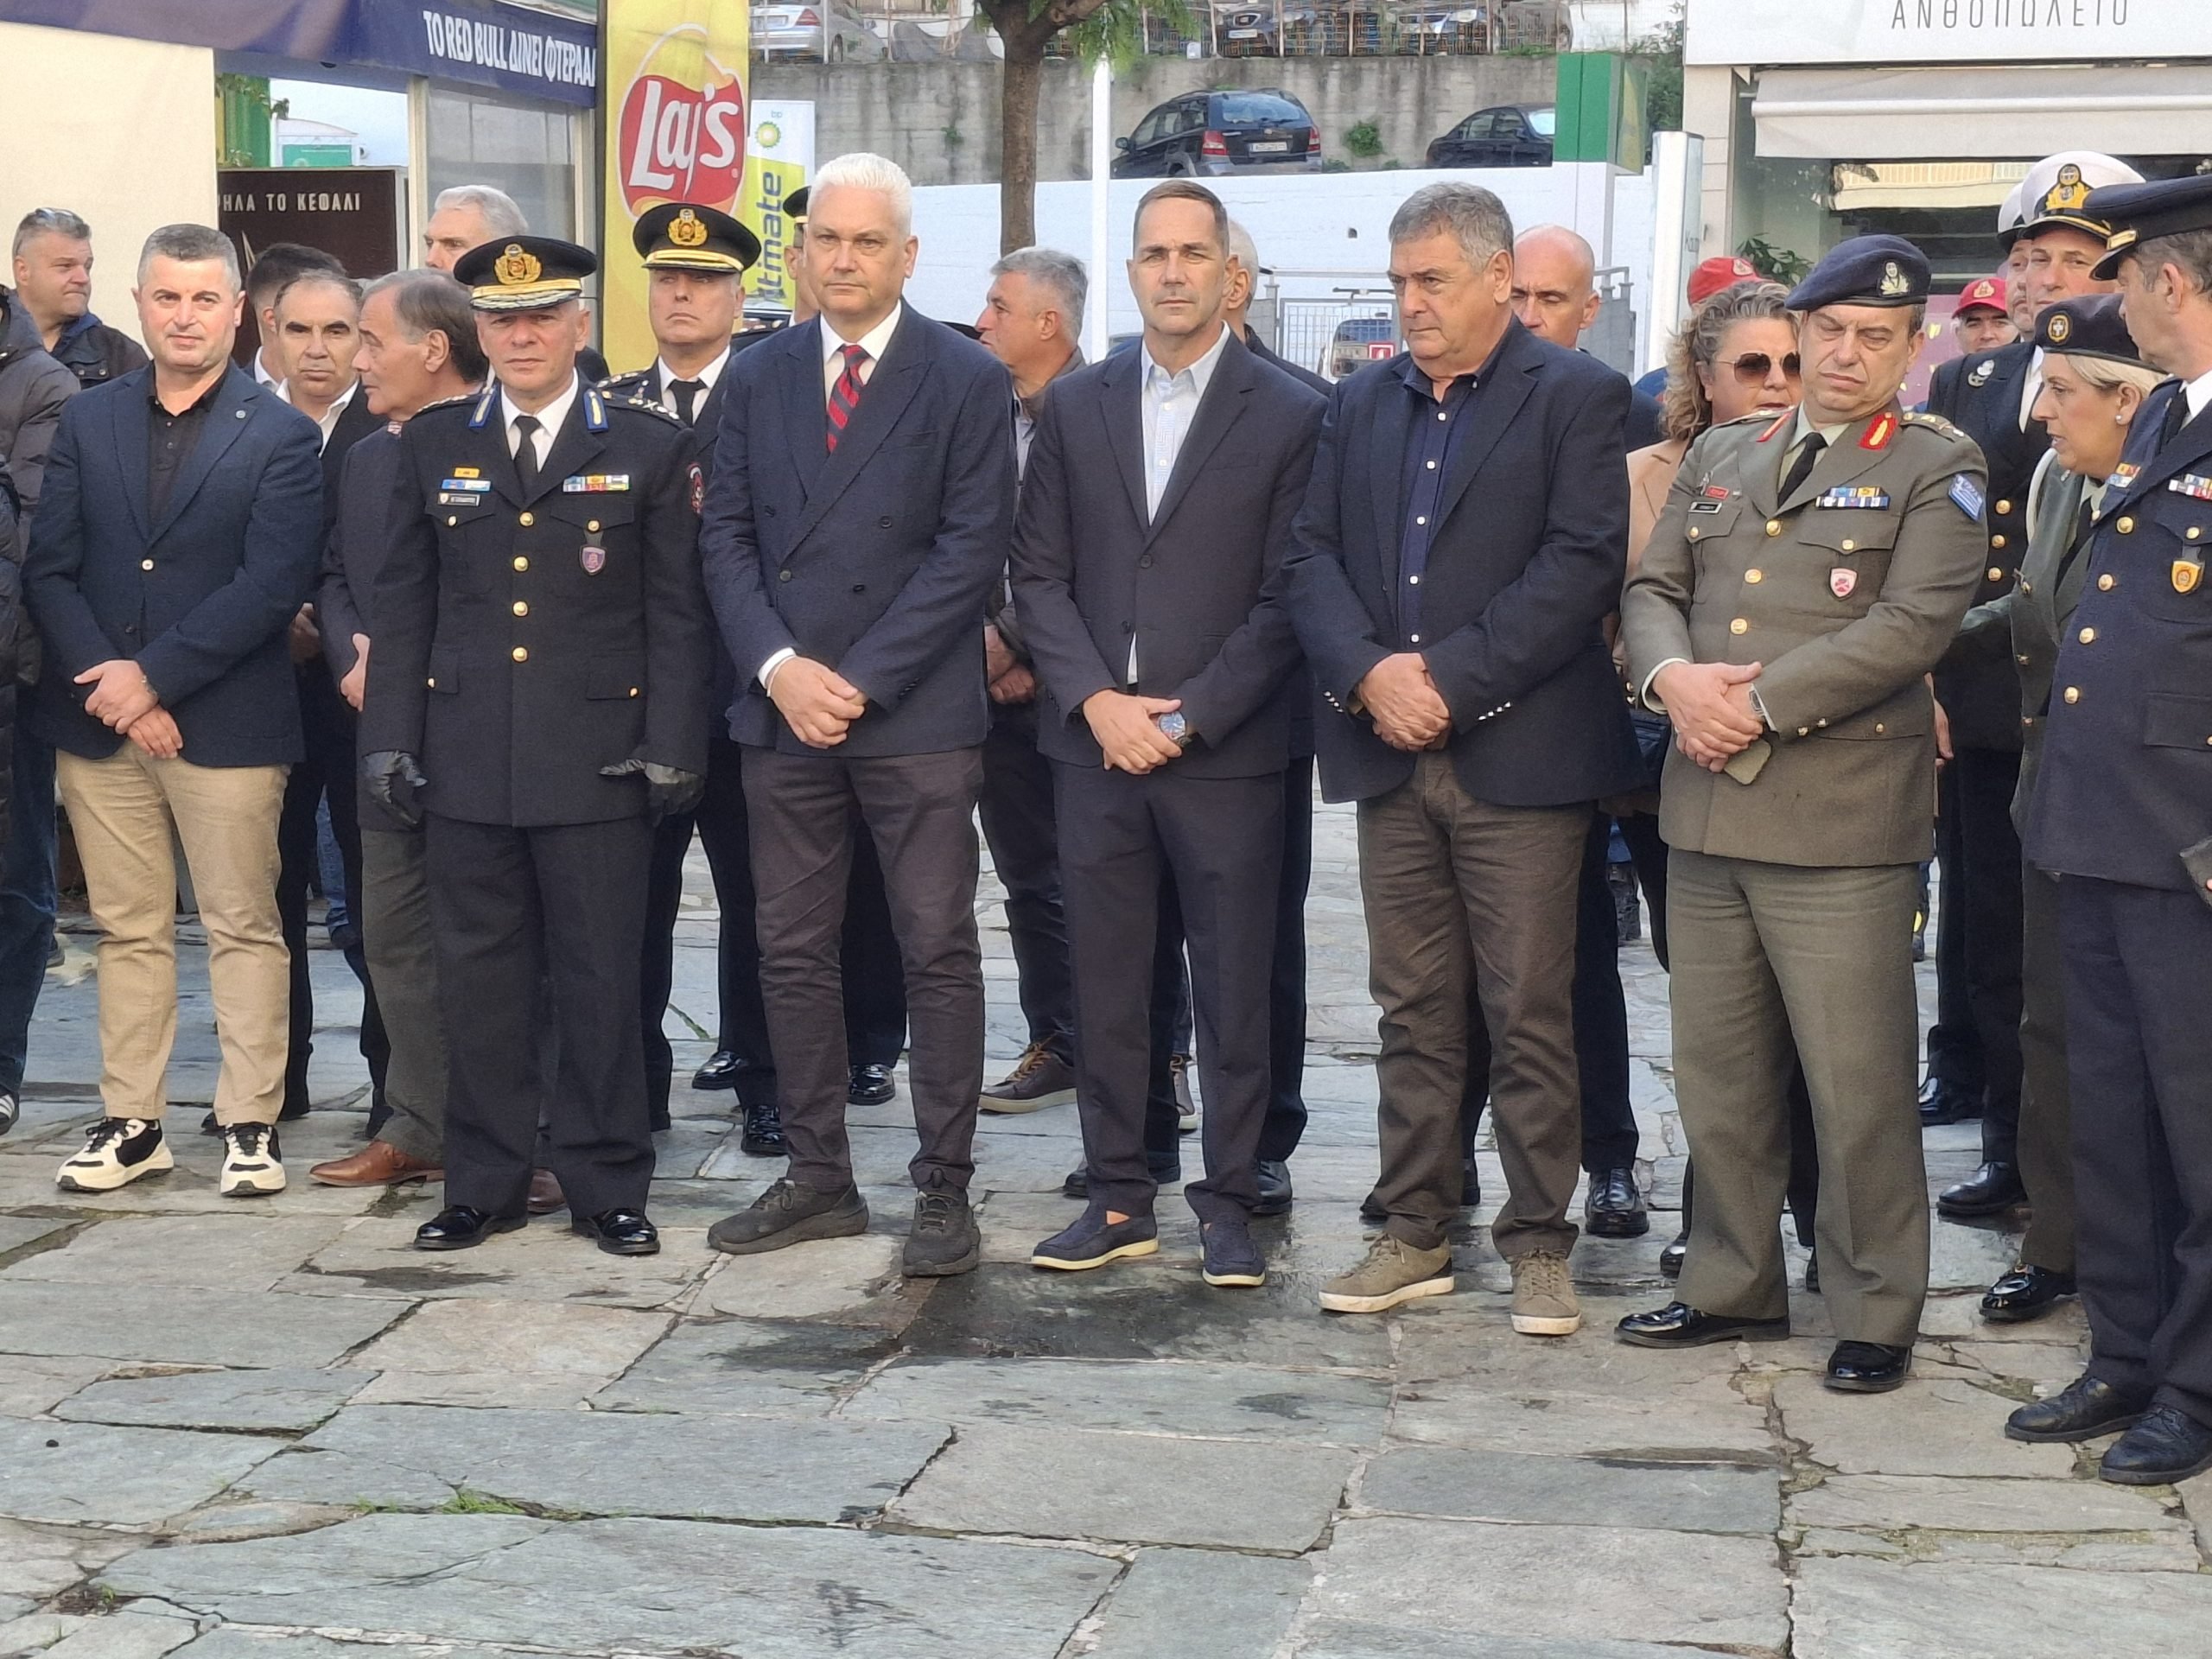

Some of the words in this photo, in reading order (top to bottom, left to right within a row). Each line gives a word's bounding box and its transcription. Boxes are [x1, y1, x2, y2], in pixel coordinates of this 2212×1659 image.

[1891, 0, 2127, 29] ΑΝΘΟΠΩΛΕΙΟ
[445, 15, 474, 62] RED
[474, 21, 508, 70] BULL
[508, 29, 543, 77] ΔΙΝΕΙ
[628, 79, 739, 201] Lay's
[296, 192, 361, 212] ΚΕΦΑΛΙ
